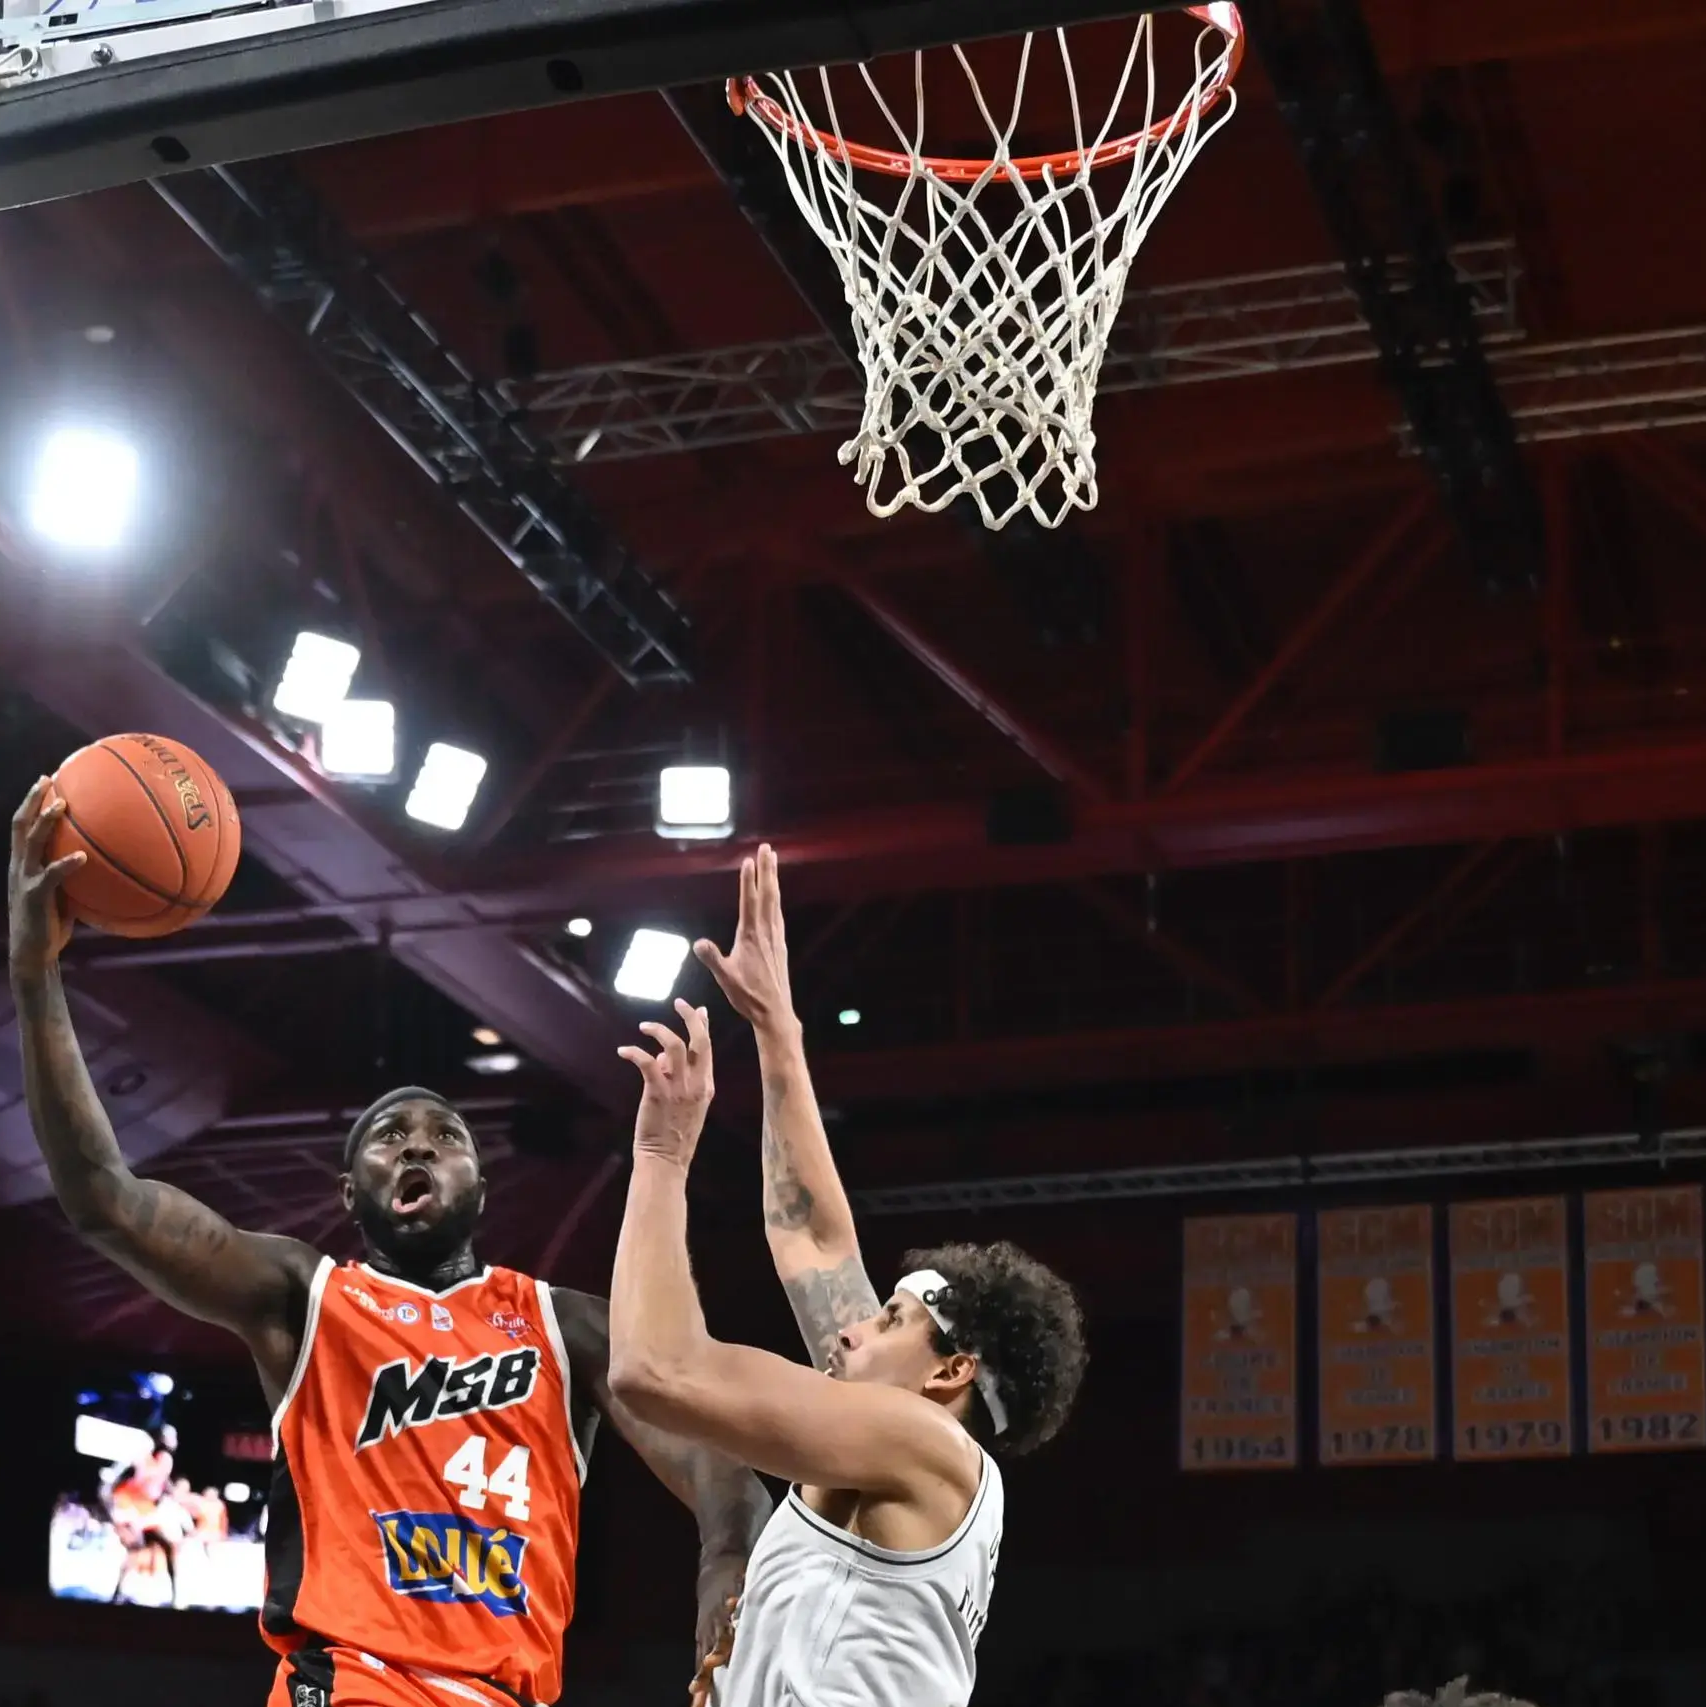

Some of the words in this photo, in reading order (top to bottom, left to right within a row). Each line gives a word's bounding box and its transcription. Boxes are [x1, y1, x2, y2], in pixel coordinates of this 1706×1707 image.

[355, 1346, 541, 1455] MSB
[1331, 1426, 1427, 1454] 1978
[1464, 1421, 1562, 1450] 1979
[1599, 1414, 1698, 1442] 1982
[444, 1435, 531, 1522] 44
[384, 1519, 521, 1598] Loué
